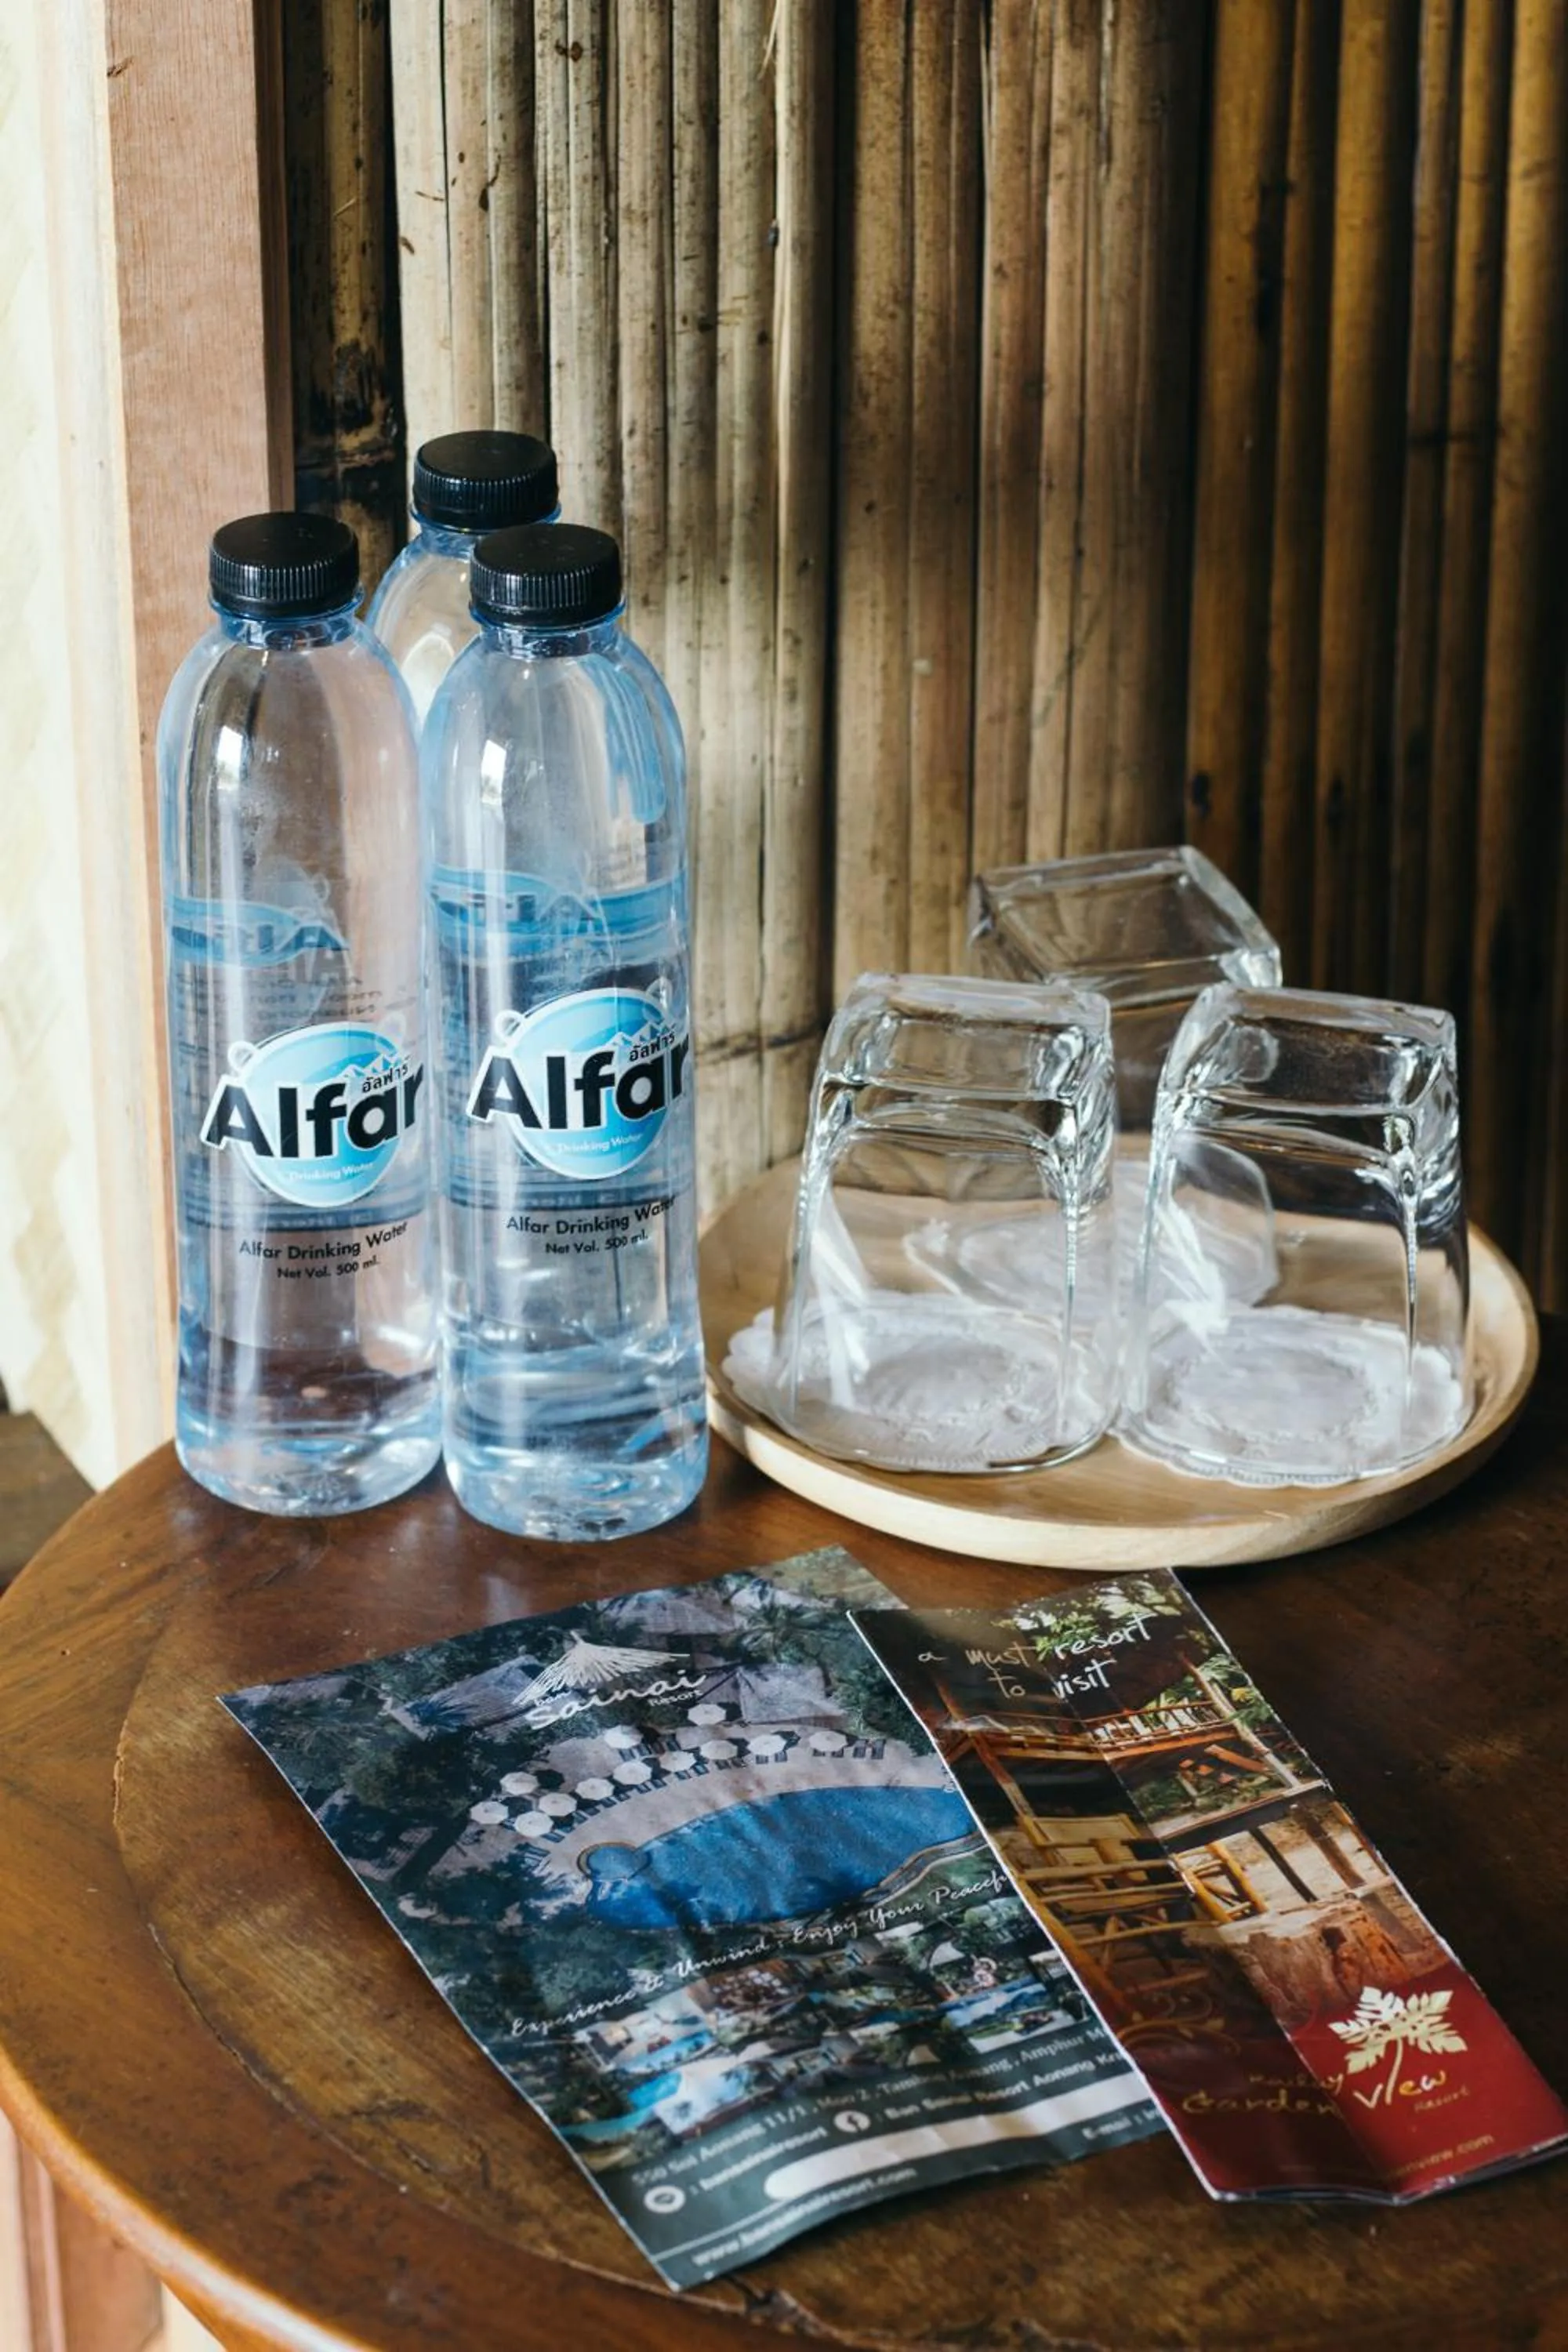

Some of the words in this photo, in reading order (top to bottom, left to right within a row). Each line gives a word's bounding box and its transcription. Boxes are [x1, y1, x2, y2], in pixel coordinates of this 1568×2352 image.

[471, 1033, 688, 1129] Alfar
[205, 1065, 424, 1158] Alfar
[557, 1141, 609, 1153] Drinking
[289, 1169, 340, 1181] Drinking
[506, 1216, 550, 1234] Alfar
[556, 1214, 629, 1236] Drinking
[634, 1196, 676, 1221] Water
[239, 1240, 281, 1260] Alfar
[288, 1240, 361, 1261] Drinking
[365, 1221, 408, 1247] Water
[546, 1243, 569, 1254] Net
[573, 1240, 600, 1254] Vol.
[604, 1236, 628, 1249] 500
[630, 1229, 648, 1243] ml.
[277, 1267, 301, 1279] Net
[304, 1265, 331, 1279] Vol.
[336, 1261, 359, 1275] 500
[362, 1255, 380, 1269] ml.
[918, 1651, 948, 1662] a
[966, 1642, 1036, 1670] must
[1054, 1612, 1159, 1661] resort
[987, 1668, 1026, 1698] to
[1053, 1658, 1117, 1699] visit
[524, 1670, 706, 1730] Sainai
[511, 1990, 637, 2037] Experience
[644, 1973, 665, 1991] &
[674, 1936, 770, 1977] Unwind
[791, 1920, 858, 1944] Enjoy
[868, 1903, 924, 1929] Your
